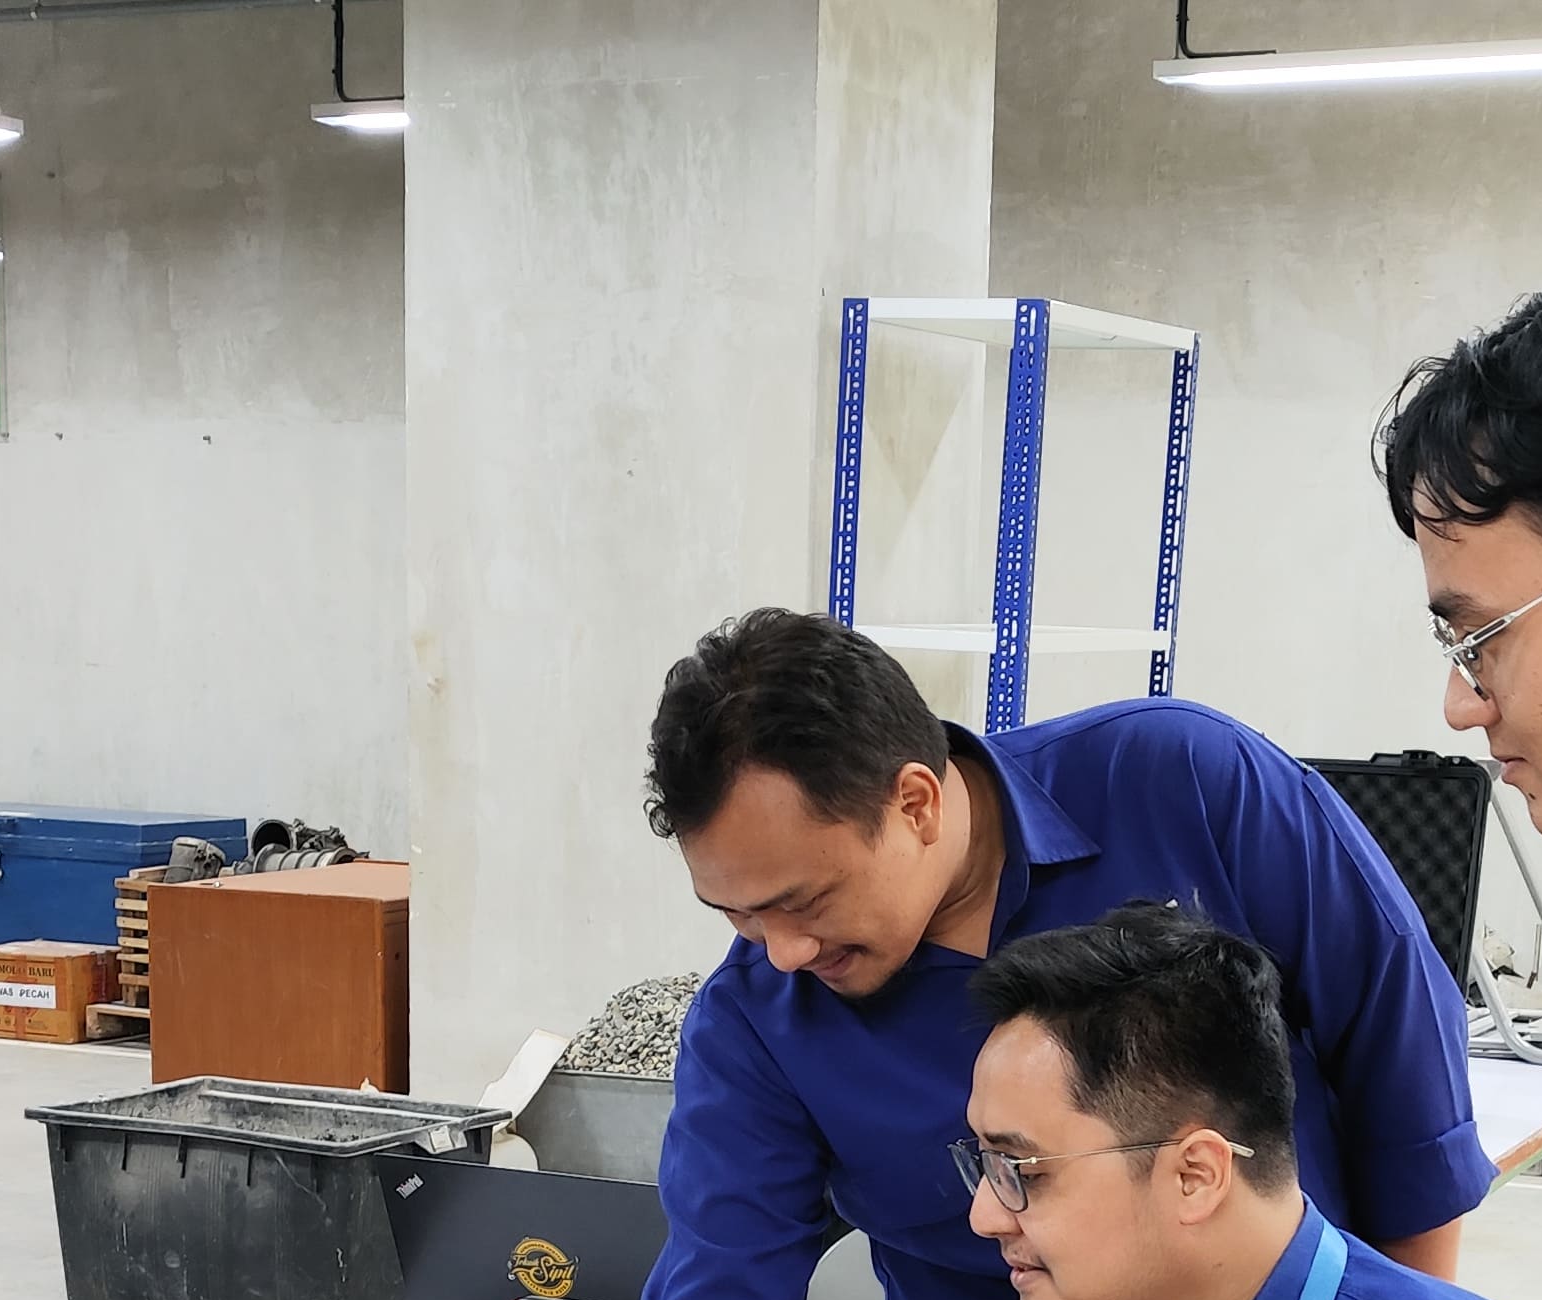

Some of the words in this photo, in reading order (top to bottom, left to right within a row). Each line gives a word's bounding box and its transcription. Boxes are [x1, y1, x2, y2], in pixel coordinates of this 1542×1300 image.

[28, 966, 55, 977] BARU
[19, 988, 50, 999] PECAH
[529, 1255, 575, 1284] Sipil
